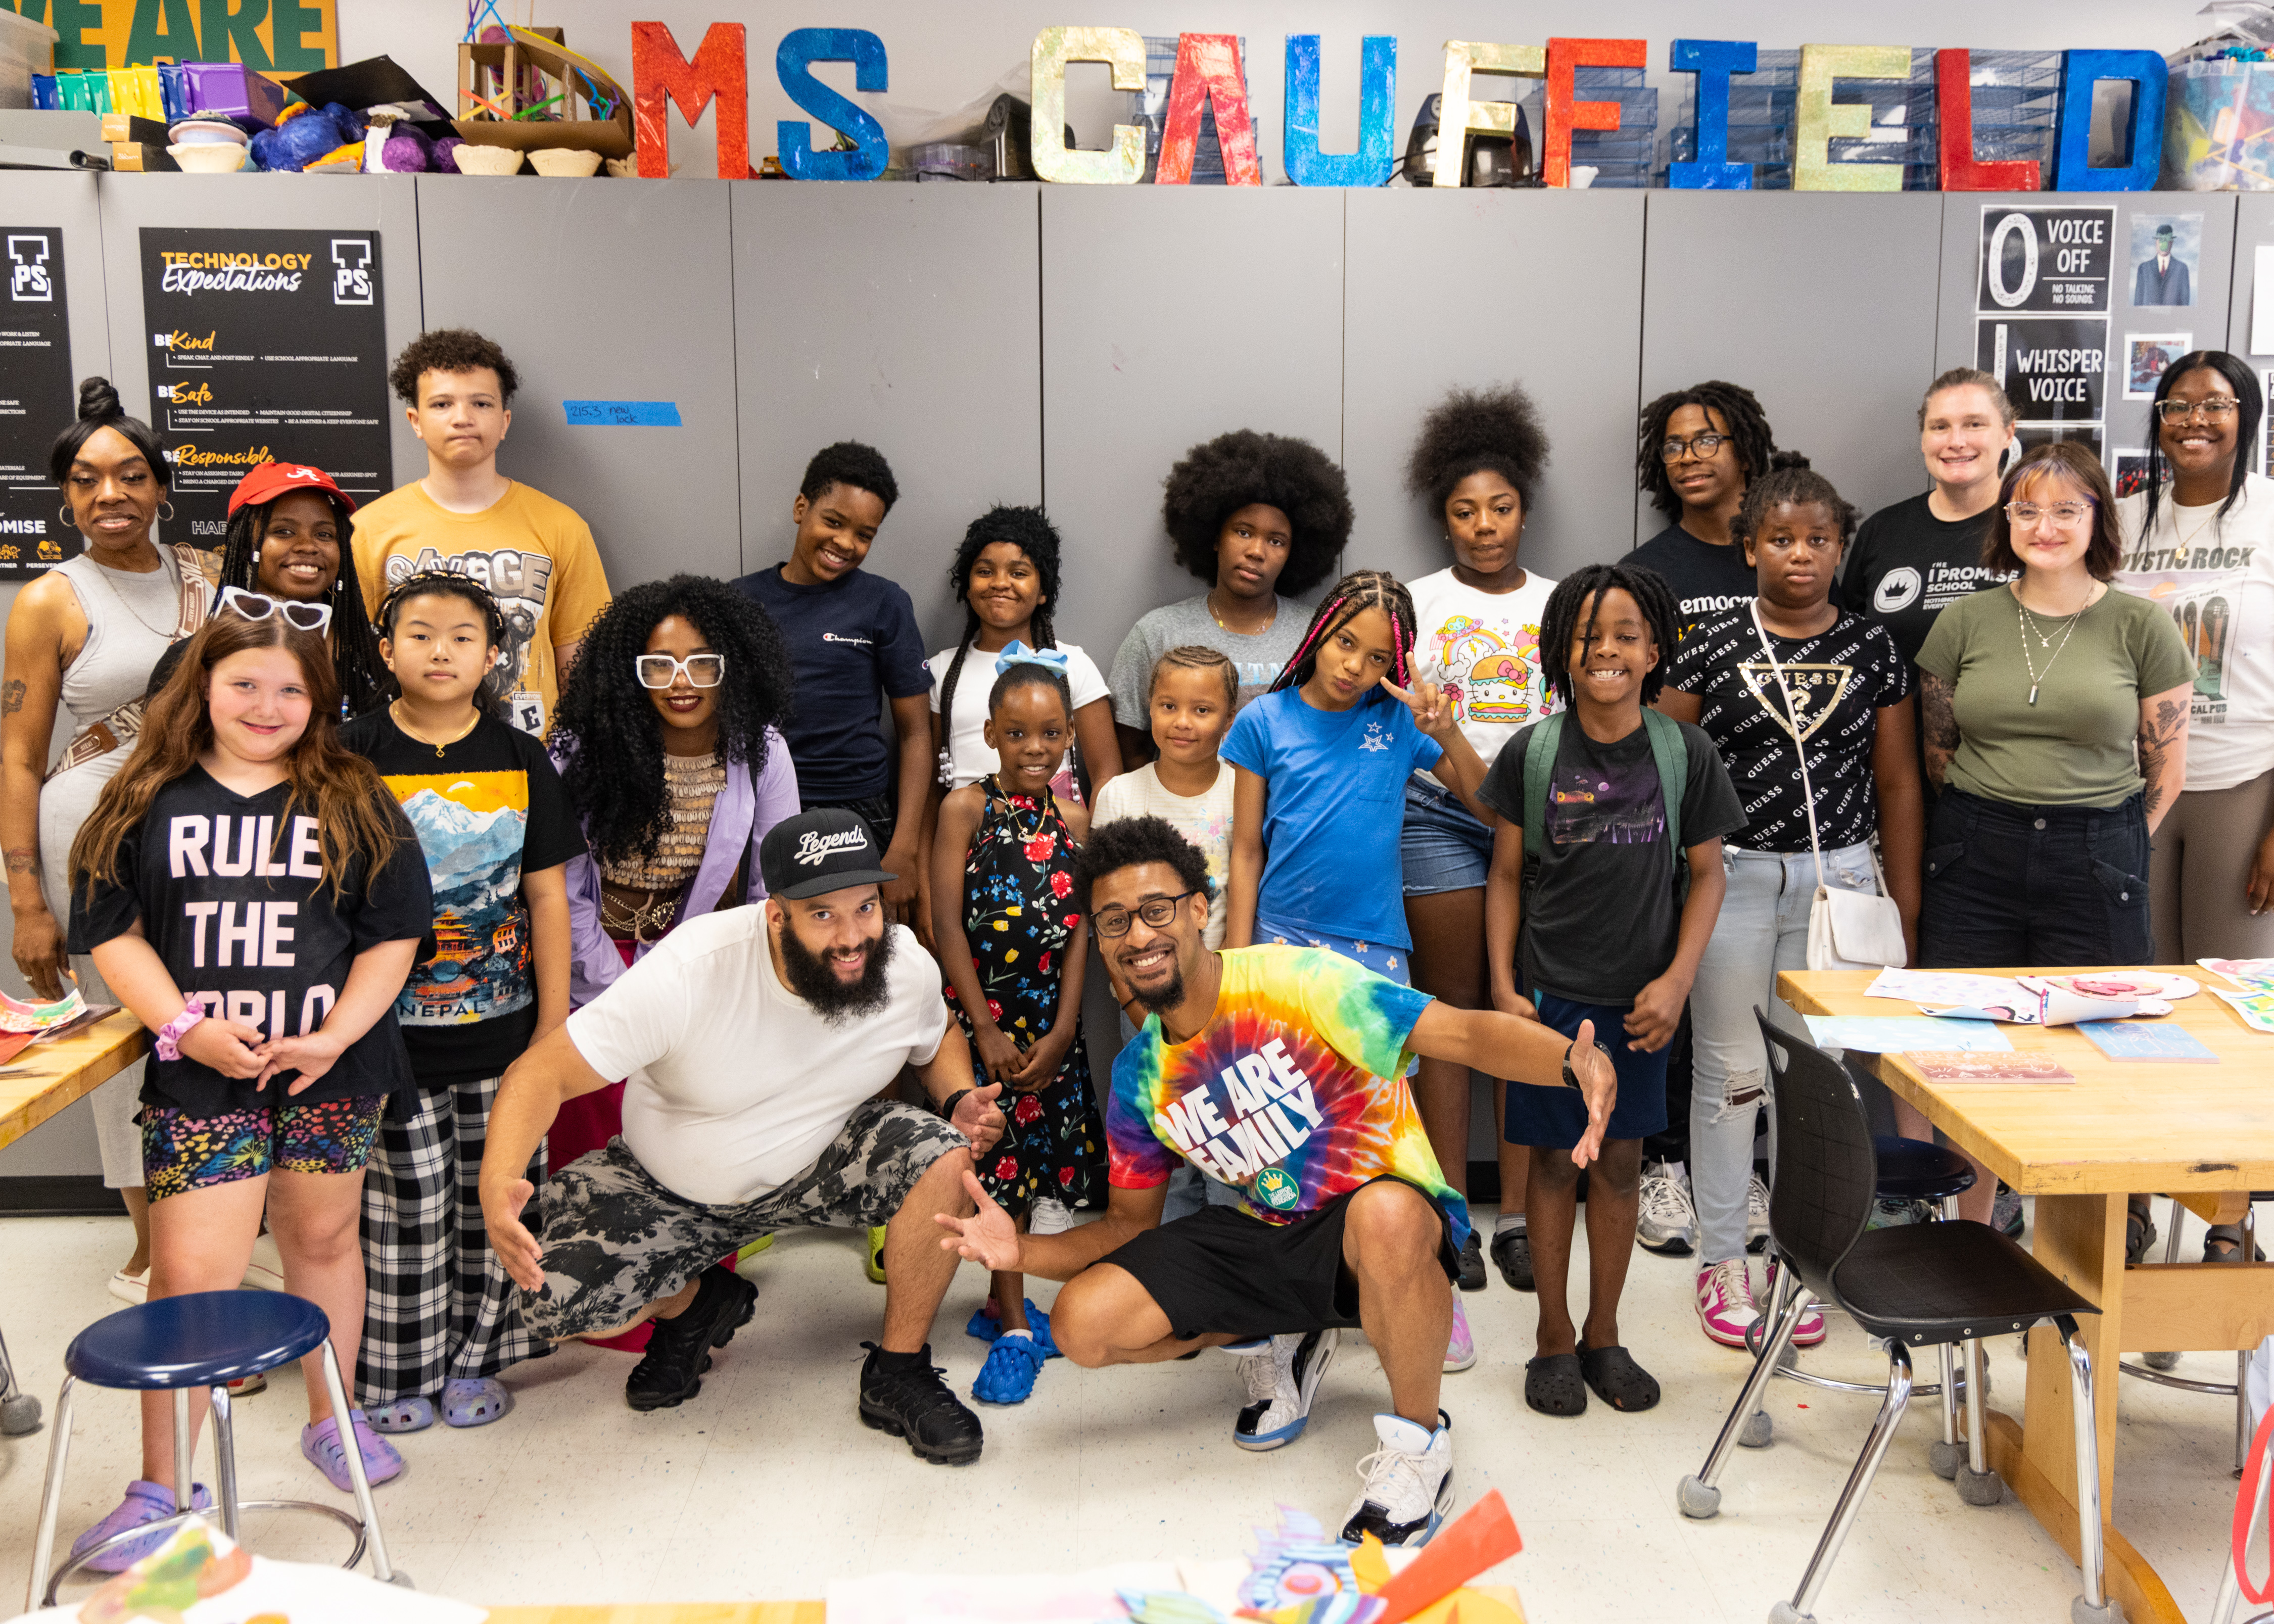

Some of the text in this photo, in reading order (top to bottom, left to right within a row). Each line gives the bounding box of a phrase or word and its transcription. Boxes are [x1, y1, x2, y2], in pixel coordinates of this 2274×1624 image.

[124, 0, 325, 72] ARE
[631, 21, 2168, 191] MS CAUFFIELD
[2047, 219, 2104, 244] VOICE
[161, 252, 312, 270] TECHNOLOGY
[2057, 249, 2091, 273] OFF
[162, 261, 302, 296] Expectations
[2052, 283, 2063, 293] NO
[2053, 294, 2064, 303] NO
[170, 329, 216, 351] Kind
[2016, 349, 2103, 373] WHISPER
[172, 381, 213, 405] Safe
[2029, 378, 2087, 401] VOICE
[571, 406, 629, 417] 215.3 new
[616, 413, 638, 424] lock
[177, 444, 275, 467] Responsible
[0, 520, 46, 534] MISE
[2190, 547, 2256, 569] ROCK
[1926, 581, 1976, 593] SCHOOL
[823, 633, 873, 646] Champion
[1677, 641, 1709, 664] GUESS
[1830, 643, 1860, 665] GUESS
[1700, 705, 1722, 727] GUESS
[2209, 704, 2227, 712] PUB
[1841, 708, 1871, 736] GUESS
[1748, 748, 1783, 778] GUESS
[1745, 785, 1783, 813] GUESS
[170, 815, 323, 878] RULE
[794, 825, 868, 866] Legends
[185, 901, 298, 967] THE
[400, 1000, 486, 1017] NEPAL
[1154, 1037, 1308, 1152] WE ARE
[1186, 1080, 1324, 1184] FAMILY
